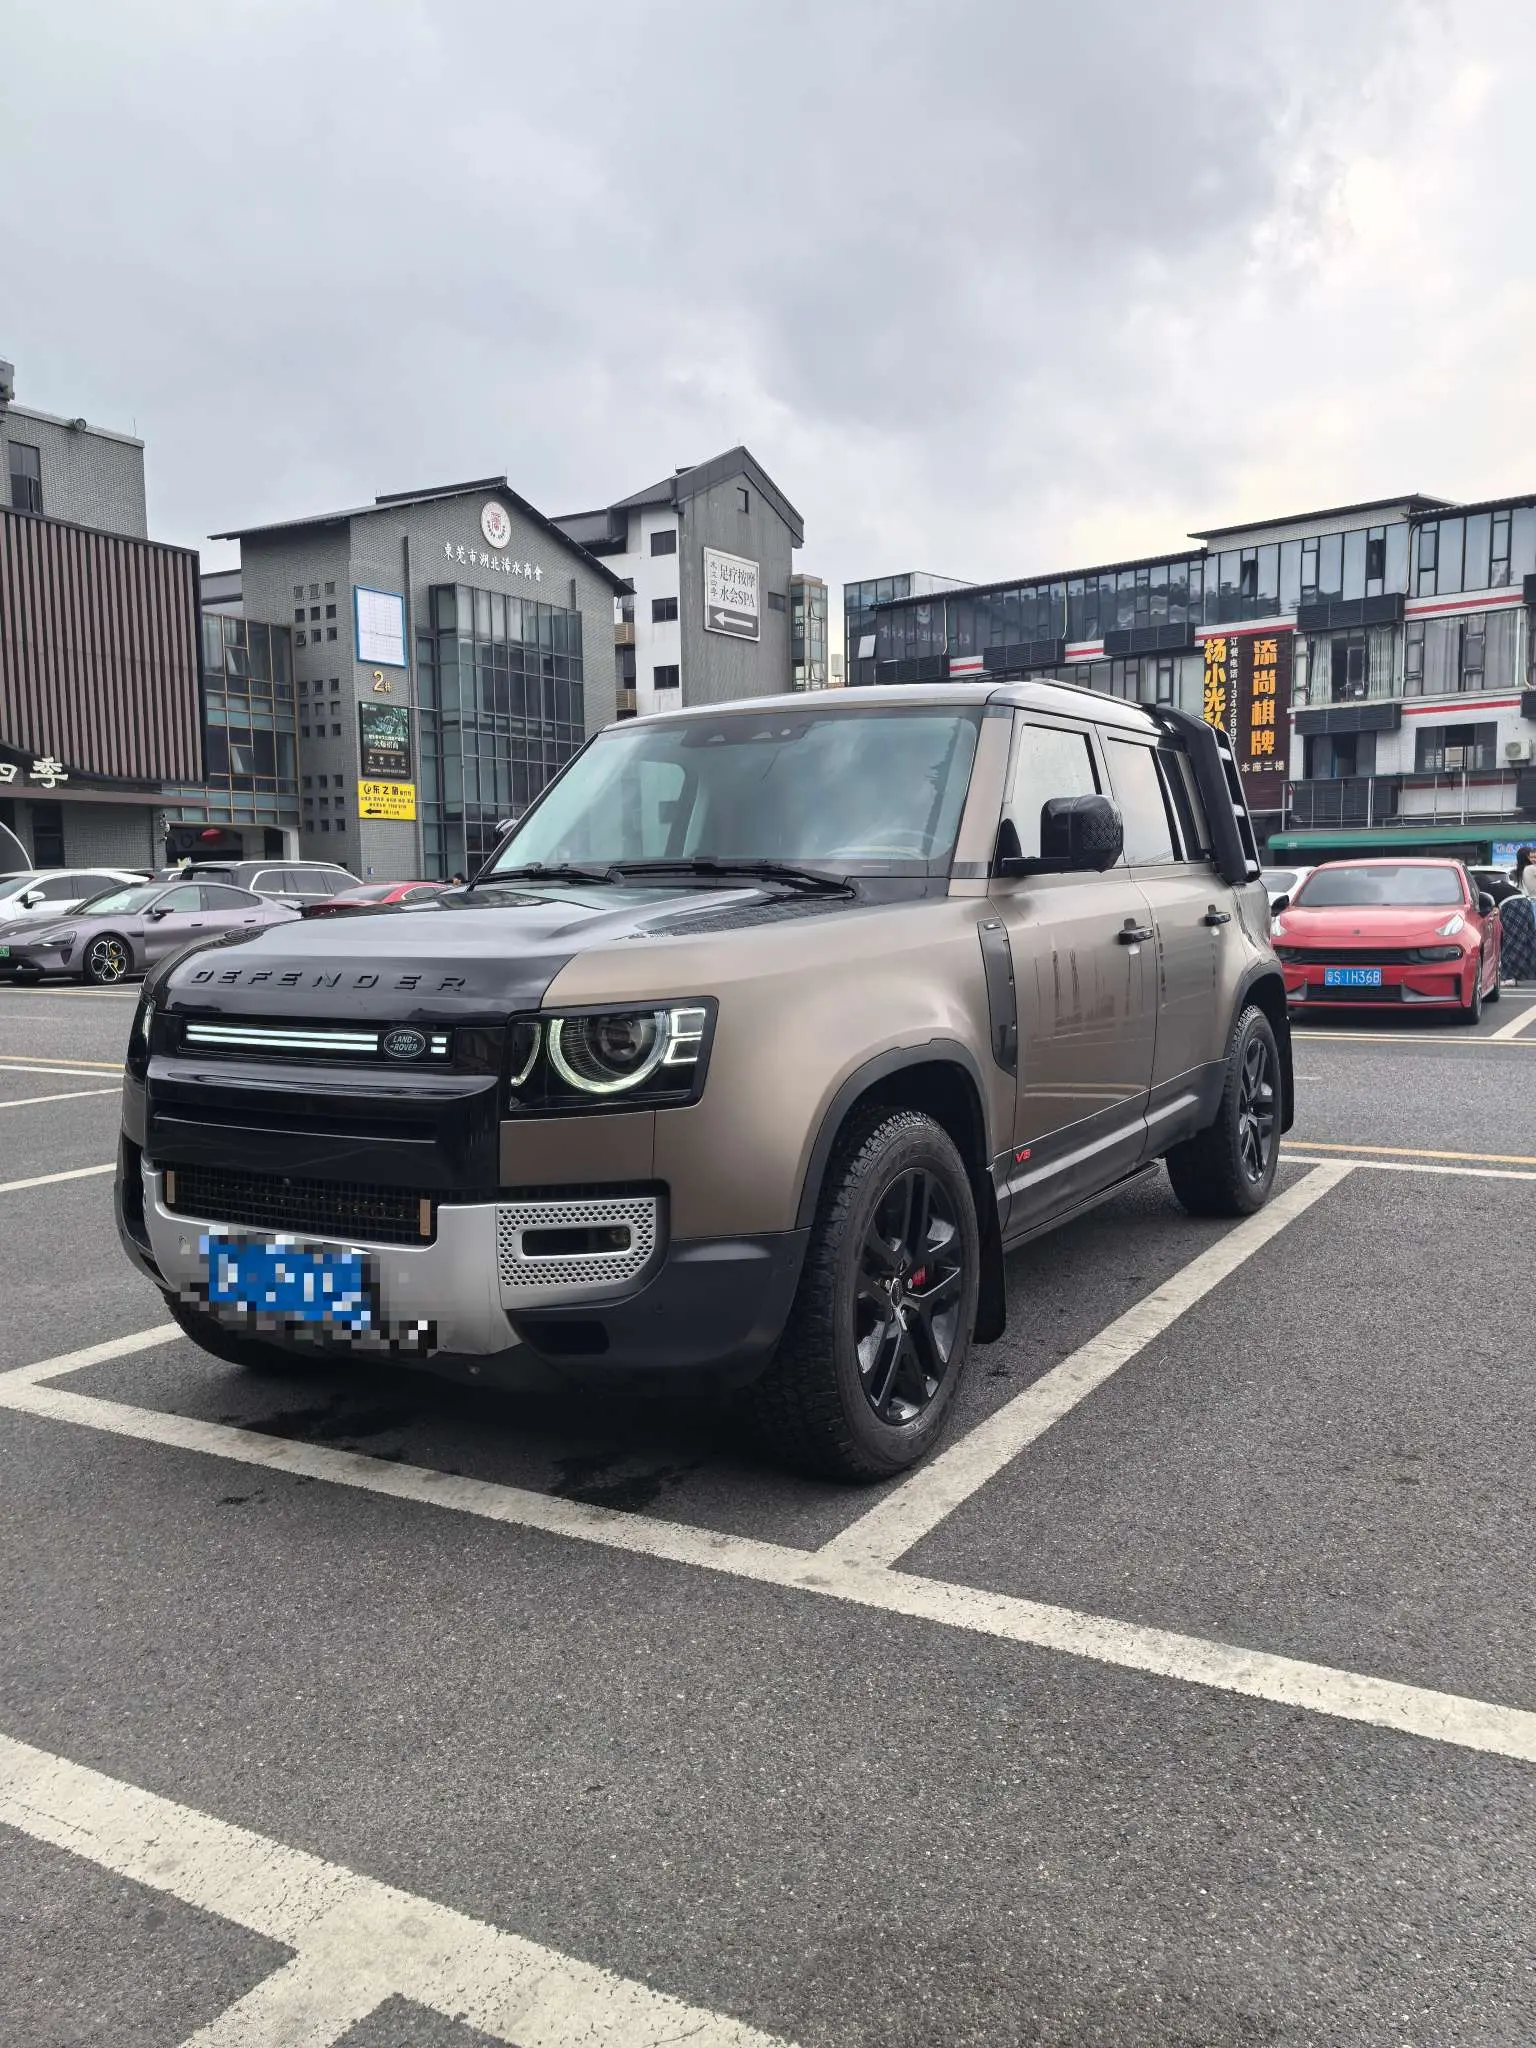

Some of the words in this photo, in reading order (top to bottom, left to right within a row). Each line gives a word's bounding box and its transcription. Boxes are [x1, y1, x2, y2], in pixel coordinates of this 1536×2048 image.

[720, 564, 756, 588] 足疗按摩
[720, 585, 755, 608] 水会SPA
[1250, 639, 1278, 756] 添尚棋牌
[1241, 760, 1285, 773] 本座二楼
[191, 970, 466, 991] DEFENDER
